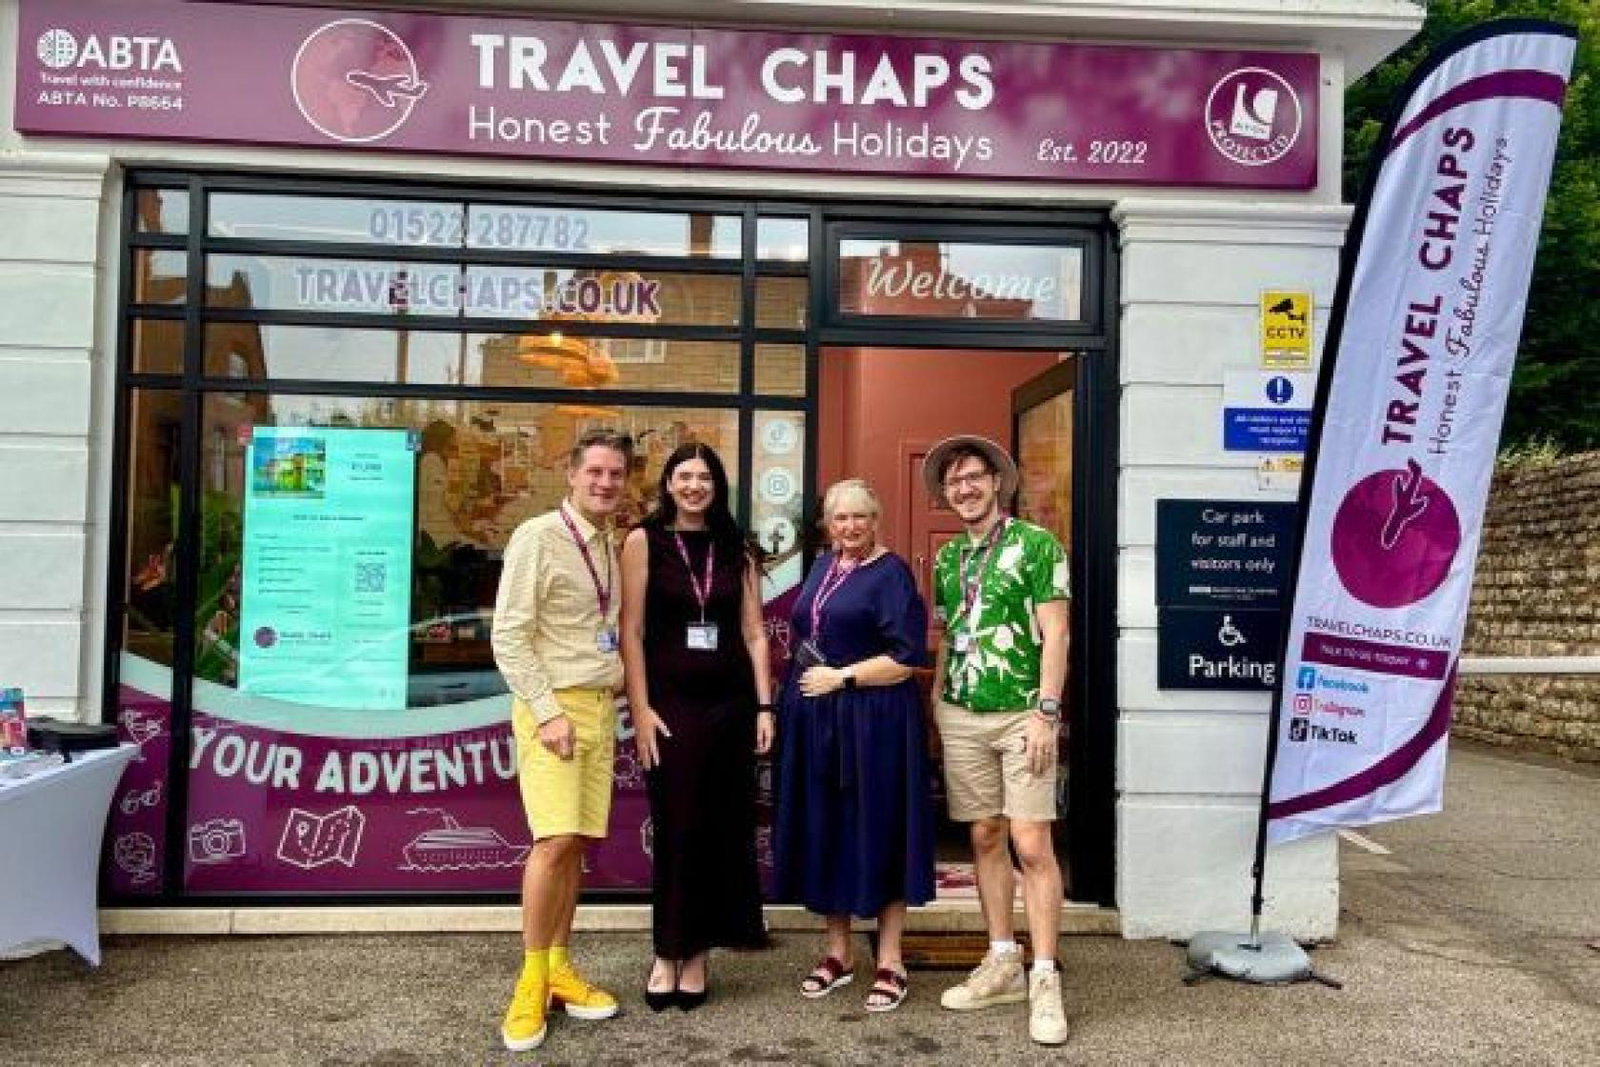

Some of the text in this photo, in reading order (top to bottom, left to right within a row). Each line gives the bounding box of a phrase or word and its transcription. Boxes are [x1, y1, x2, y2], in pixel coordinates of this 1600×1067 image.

[77, 36, 182, 72] ABTA
[41, 72, 182, 89] Travel with confidence
[469, 34, 995, 110] TRAVEL CHAPS
[37, 90, 86, 106] ABTA
[92, 93, 122, 107] No.
[468, 106, 994, 168] Honest Fabulous Holidays
[1037, 138, 1148, 164] Est. 2022
[369, 207, 590, 248] 01522 287782
[296, 268, 661, 317] TRAVELCHAPS.CO.UK
[866, 257, 1056, 301] Welcome
[1381, 127, 1474, 445] TRAVEL CHAPS
[1427, 136, 1512, 455] Honest Fabulous Holidays
[1265, 327, 1306, 340] CCTV
[1202, 509, 1265, 526] Car park
[1191, 531, 1276, 548] for staff and
[1191, 557, 1276, 574] visitors only
[1307, 616, 1451, 648] TRAVELCHAPS.CO.UK
[1188, 653, 1276, 686] Parking
[1311, 725, 1358, 745] TikTok
[190, 727, 519, 794] YOUR ADVENTU
